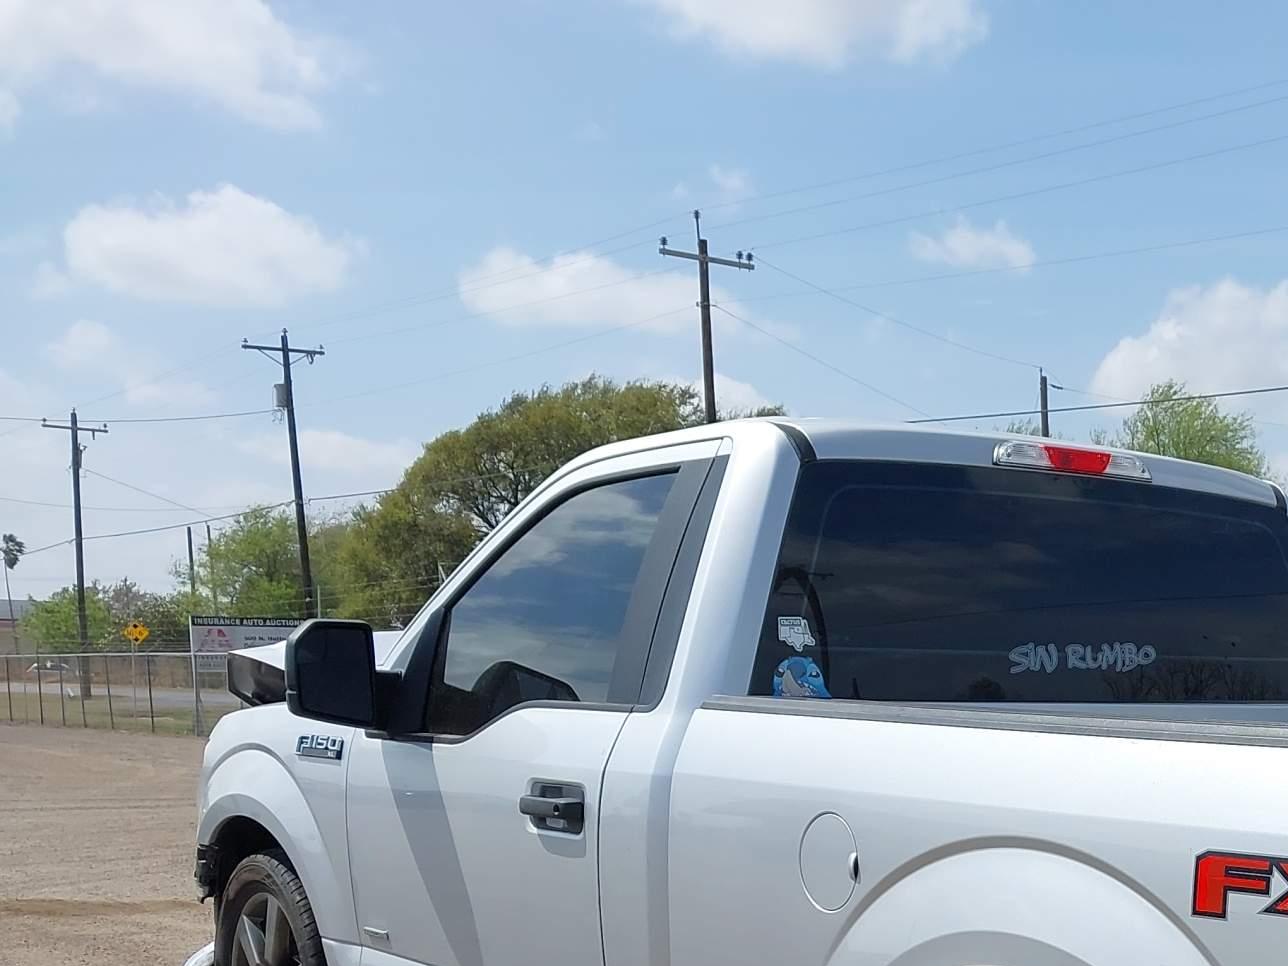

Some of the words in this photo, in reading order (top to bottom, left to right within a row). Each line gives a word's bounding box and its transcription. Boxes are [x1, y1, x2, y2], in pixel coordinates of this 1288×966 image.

[194, 617, 241, 626] INSURANCE
[243, 618, 264, 627] AUTO
[1008, 642, 1059, 674] SIN
[1065, 642, 1157, 672] RUMBO
